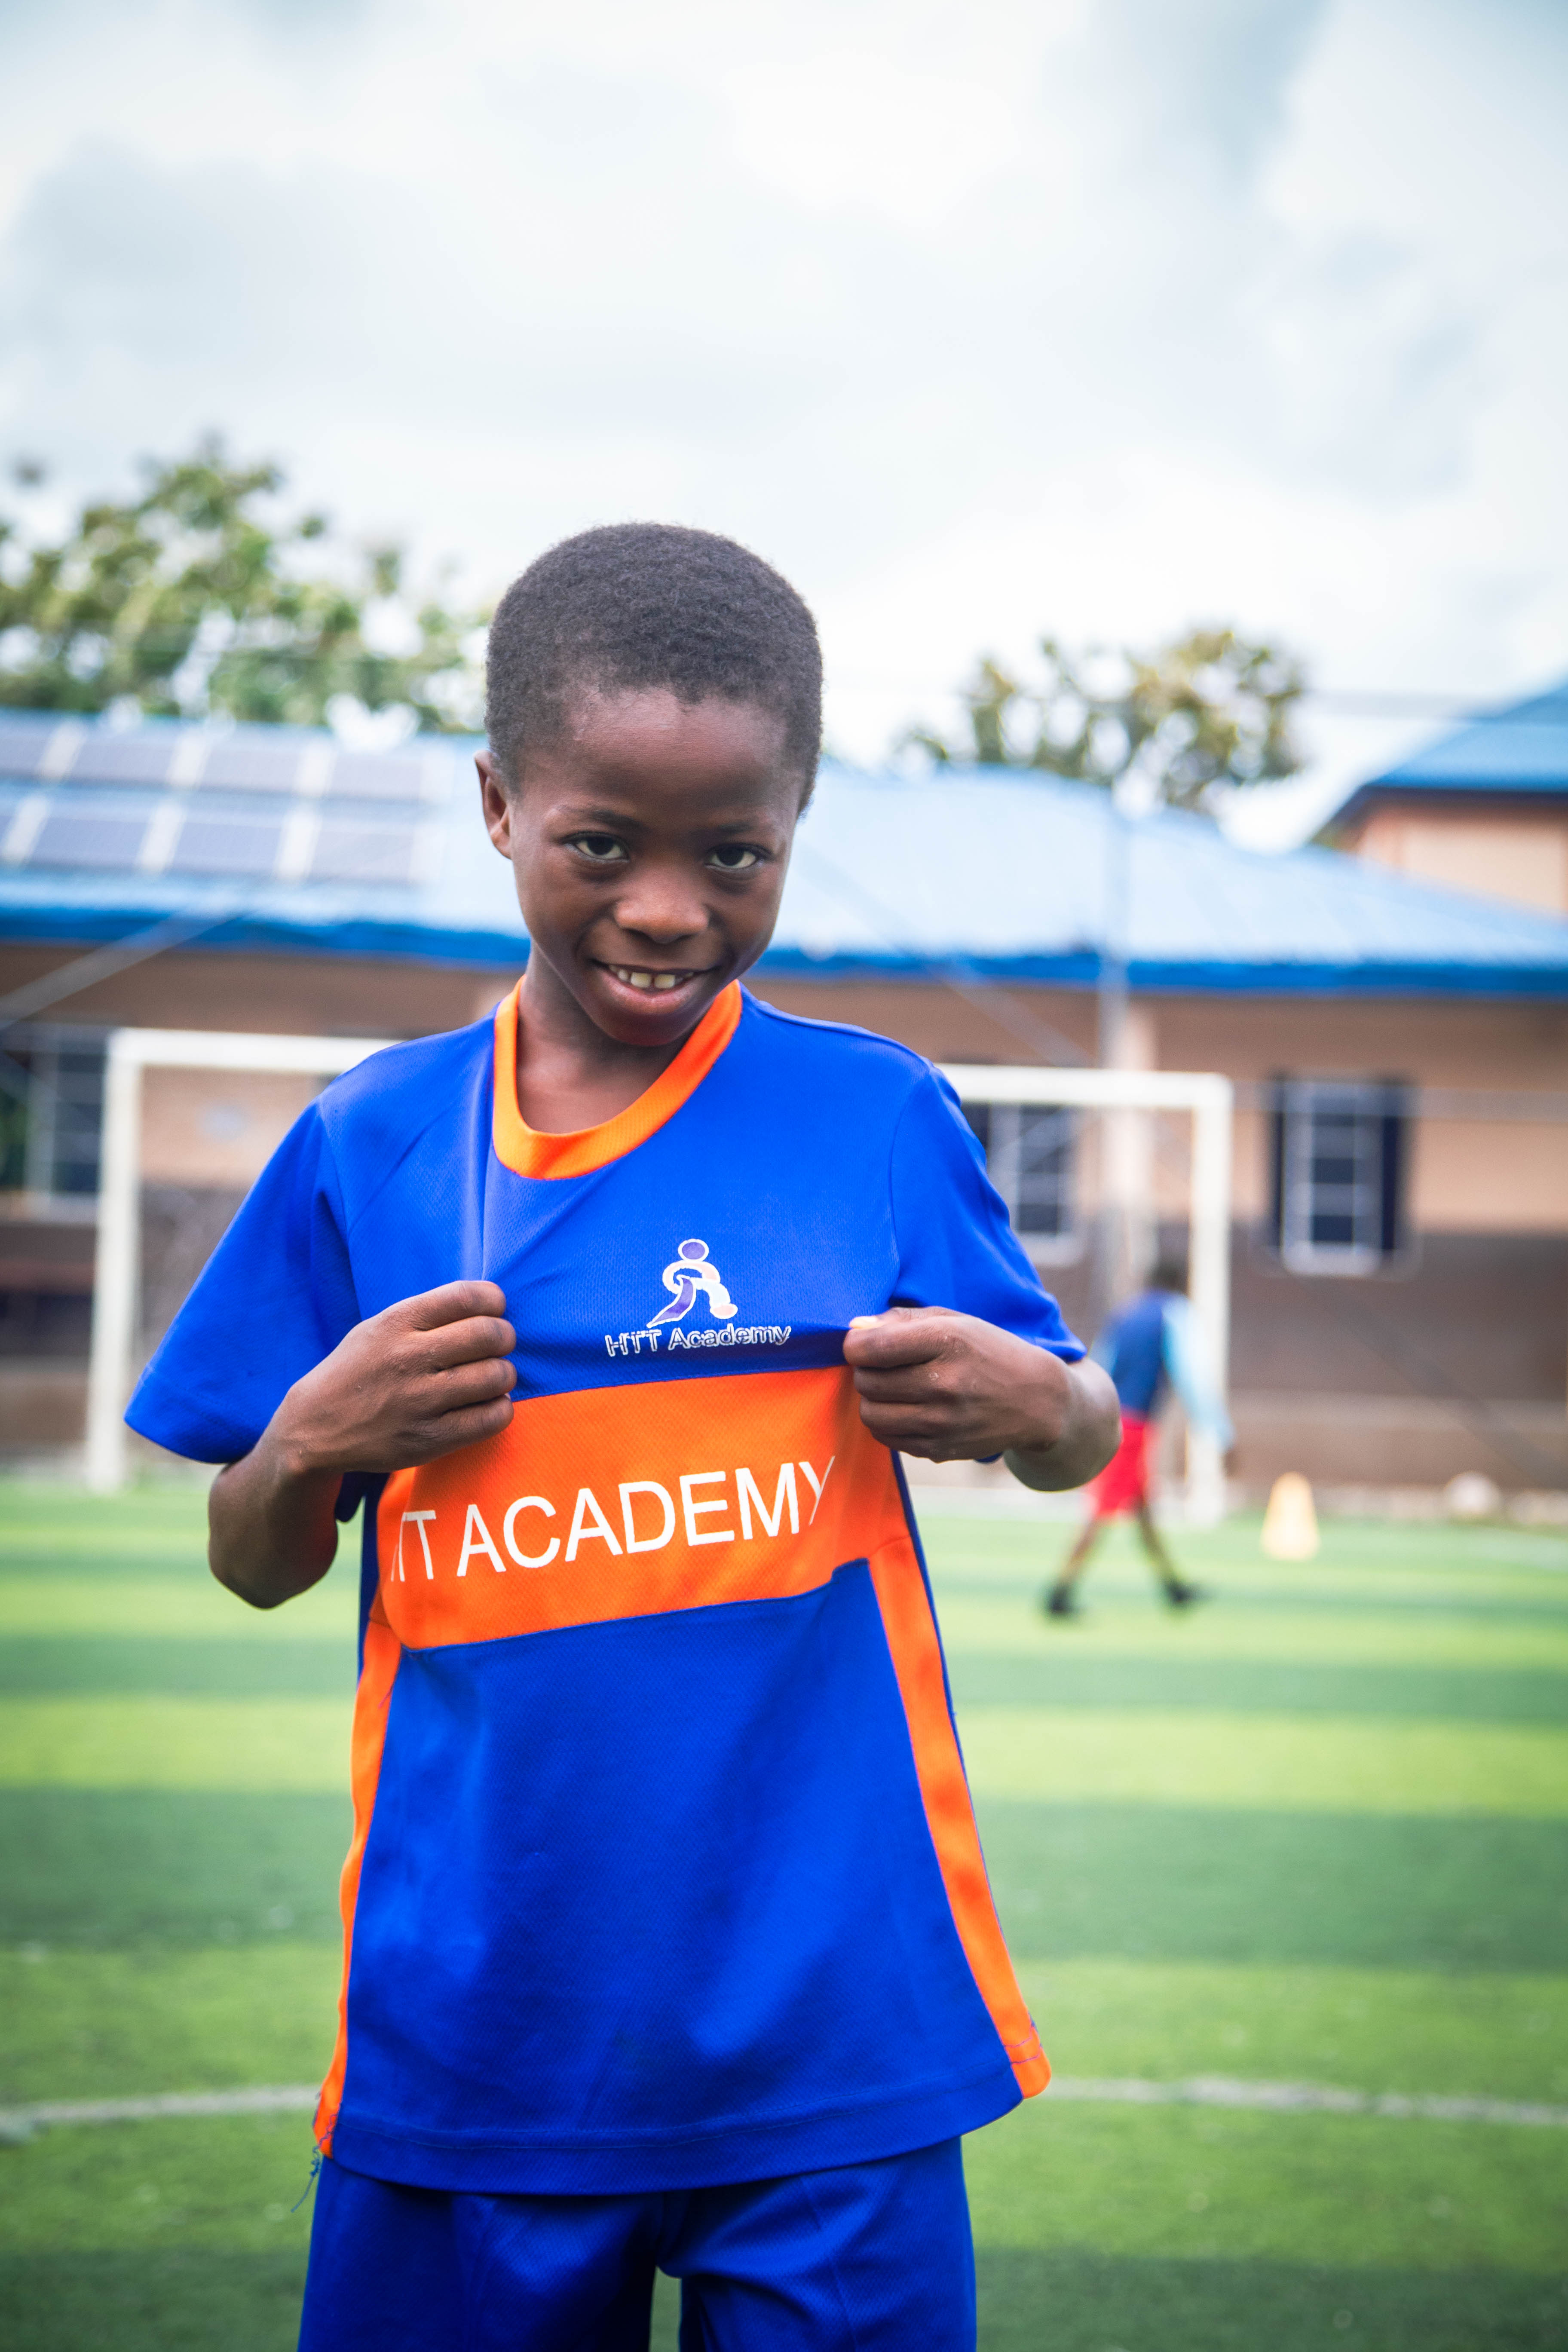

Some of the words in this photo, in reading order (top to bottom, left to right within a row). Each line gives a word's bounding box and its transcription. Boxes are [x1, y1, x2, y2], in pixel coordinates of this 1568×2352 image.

[604, 1329, 662, 1357] HTT
[668, 1323, 792, 1351] Academy
[456, 1455, 836, 1577] ACADEMY
